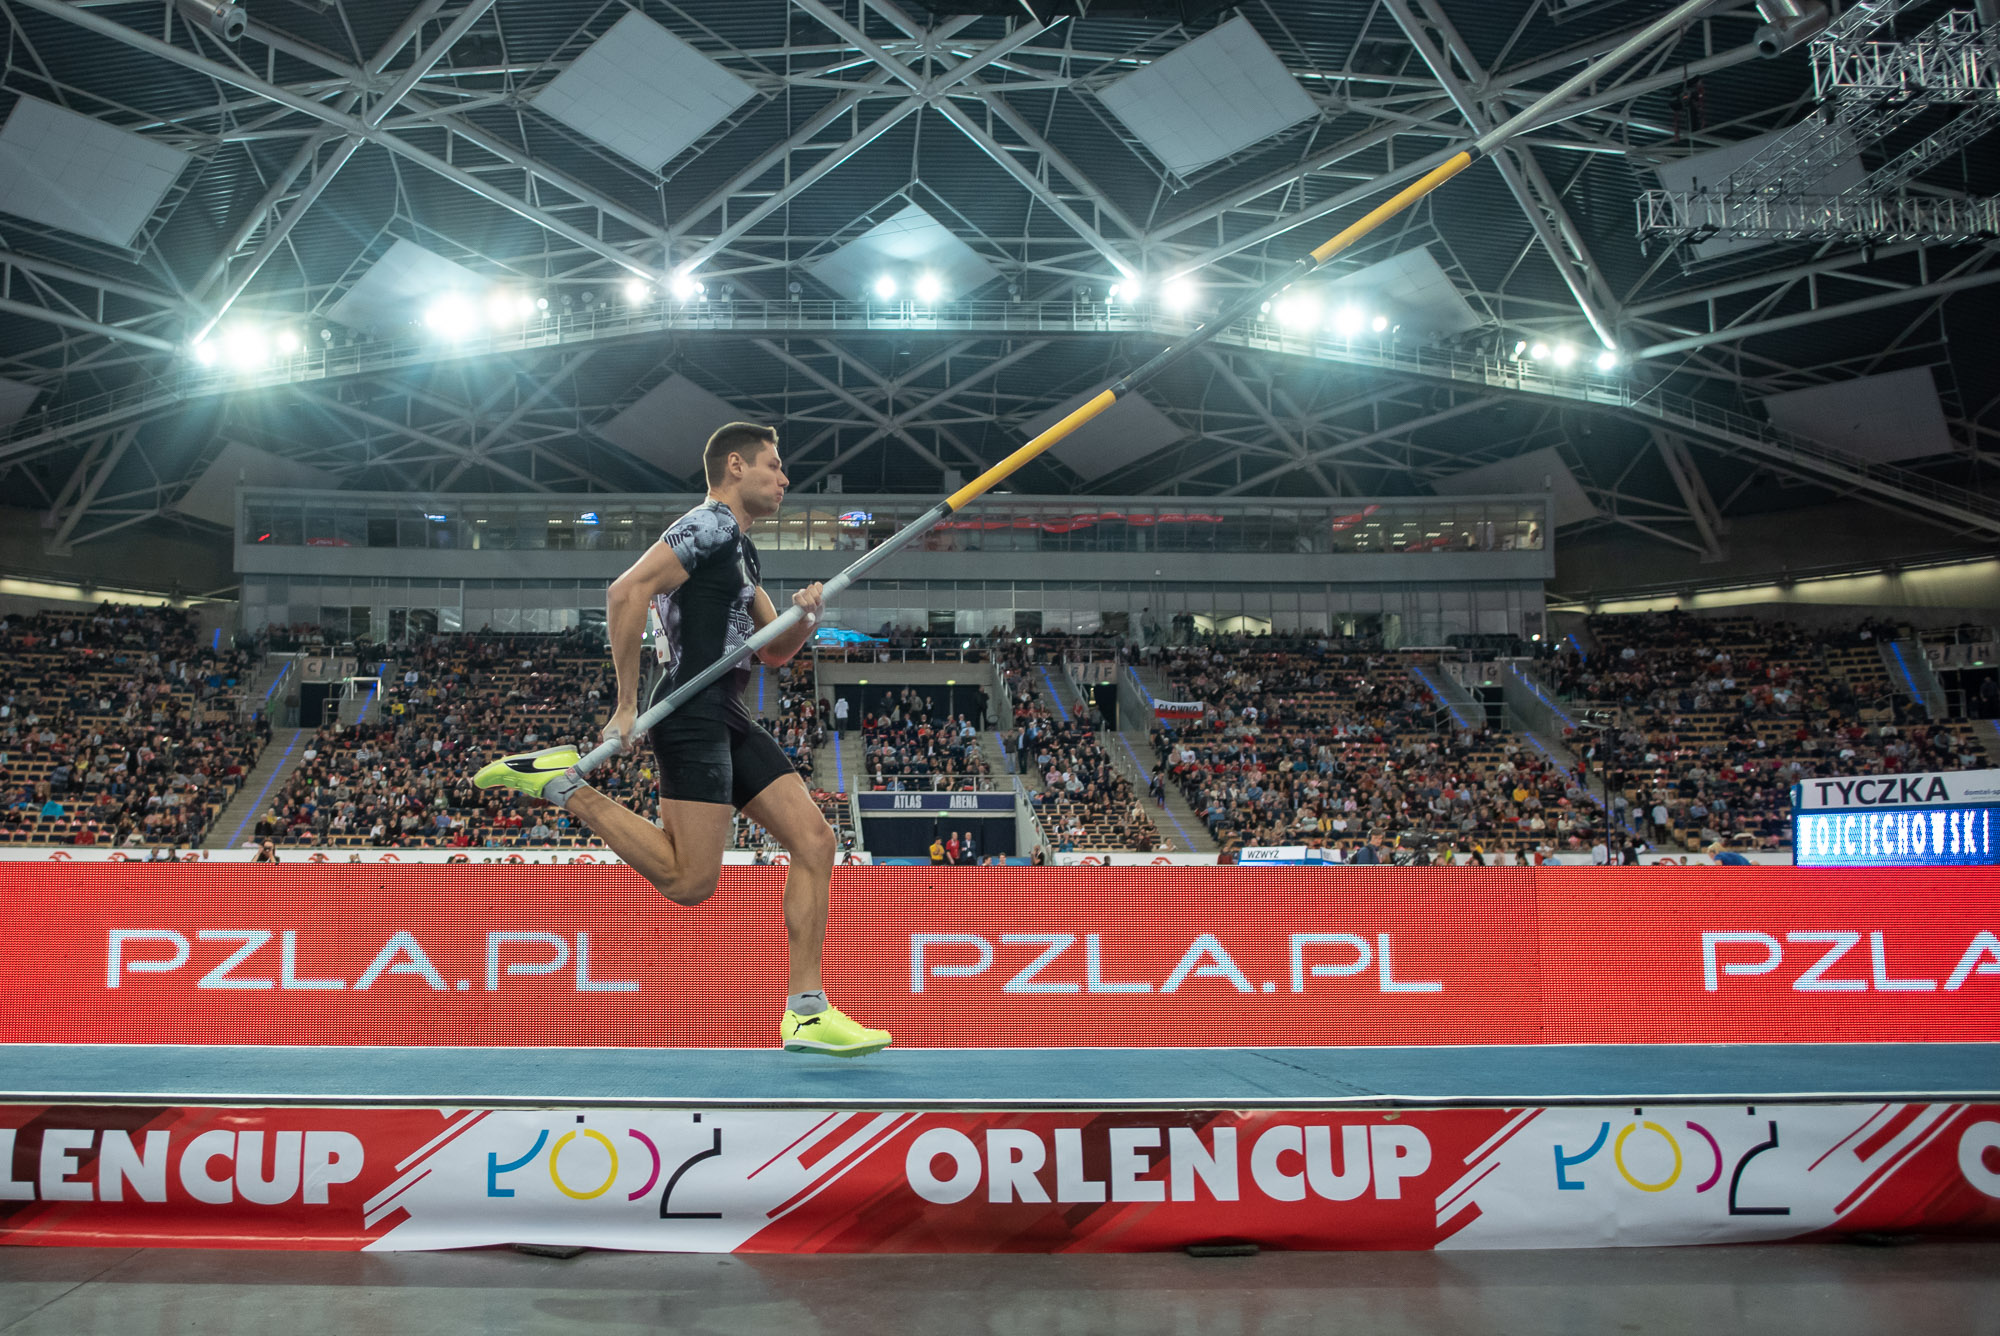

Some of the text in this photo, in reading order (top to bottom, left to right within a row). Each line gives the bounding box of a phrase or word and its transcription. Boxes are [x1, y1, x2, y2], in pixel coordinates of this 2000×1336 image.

[893, 795, 978, 809] ATLAS ARENA
[1815, 776, 1950, 806] TYCZKA
[1799, 808, 1990, 856] WOJCIECHOWSKI
[106, 928, 641, 993] PZLA.PL
[910, 931, 1443, 995] PZLA.PL
[179, 1129, 364, 1205] CUP
[905, 1124, 1431, 1205] ORLEN CUP
